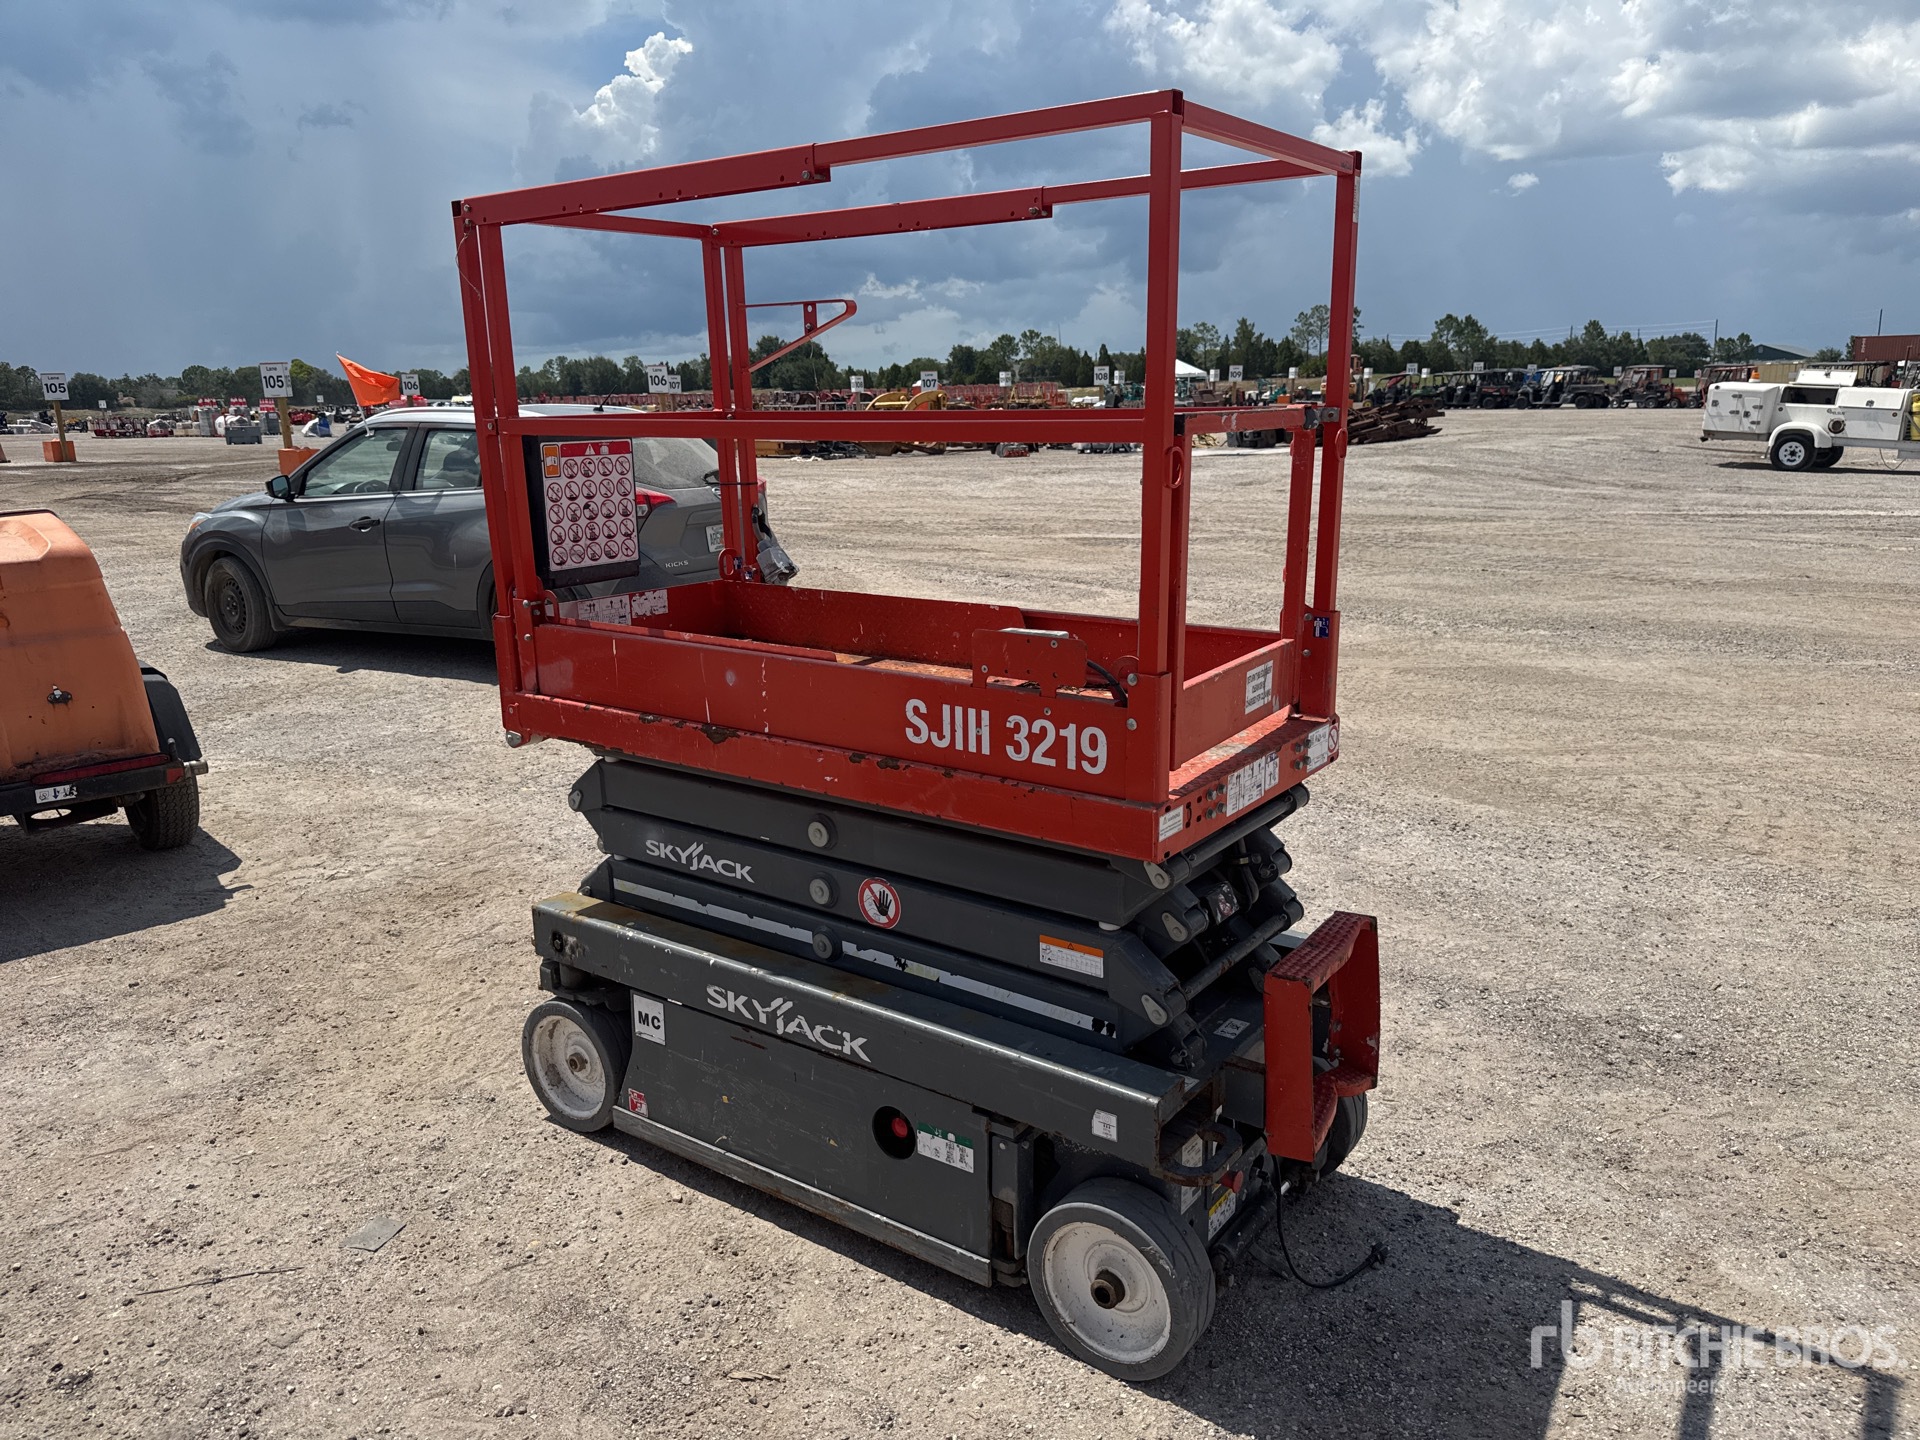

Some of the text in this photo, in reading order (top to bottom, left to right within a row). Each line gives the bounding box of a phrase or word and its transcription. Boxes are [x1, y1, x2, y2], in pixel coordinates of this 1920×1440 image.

[649, 375, 667, 386] 106
[1095, 372, 1108, 381] 108
[1230, 371, 1242, 379] 109
[262, 375, 284, 389] 105
[403, 381, 419, 391] 106
[669, 381, 681, 390] 107
[922, 379, 937, 388] 107
[44, 382, 68, 394] 105
[665, 560, 689, 568] KICKS
[1005, 714, 1108, 775] 3219
[645, 839, 755, 883] SKYJACK
[637, 1010, 661, 1031] MC
[706, 983, 872, 1063] SKYJACK
